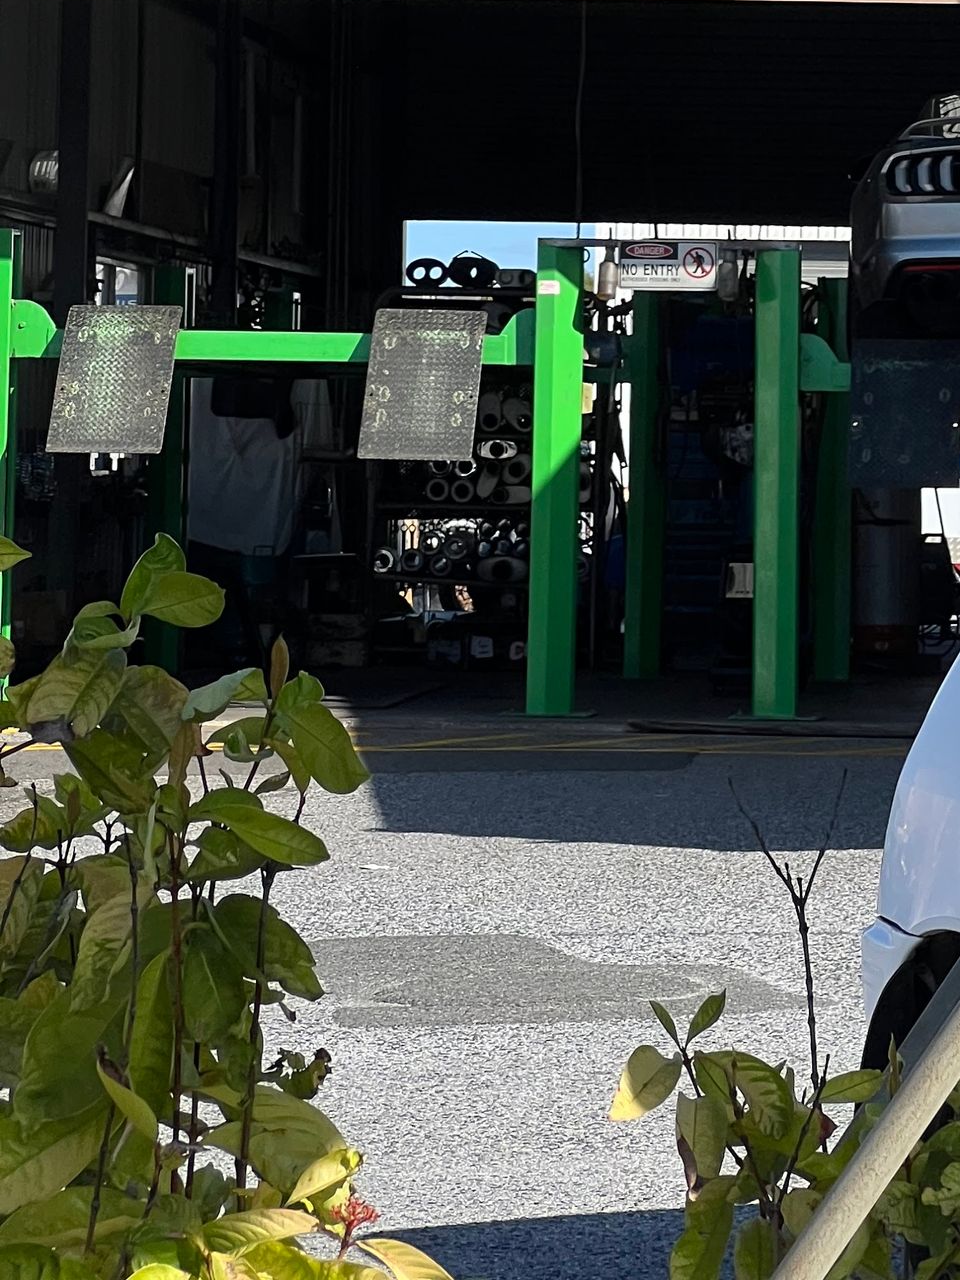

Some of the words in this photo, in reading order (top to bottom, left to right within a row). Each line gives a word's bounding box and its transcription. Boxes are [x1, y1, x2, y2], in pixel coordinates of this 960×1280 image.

[634, 246, 665, 255] DANGER
[622, 264, 638, 275] NO
[643, 264, 680, 276] ENTRY
